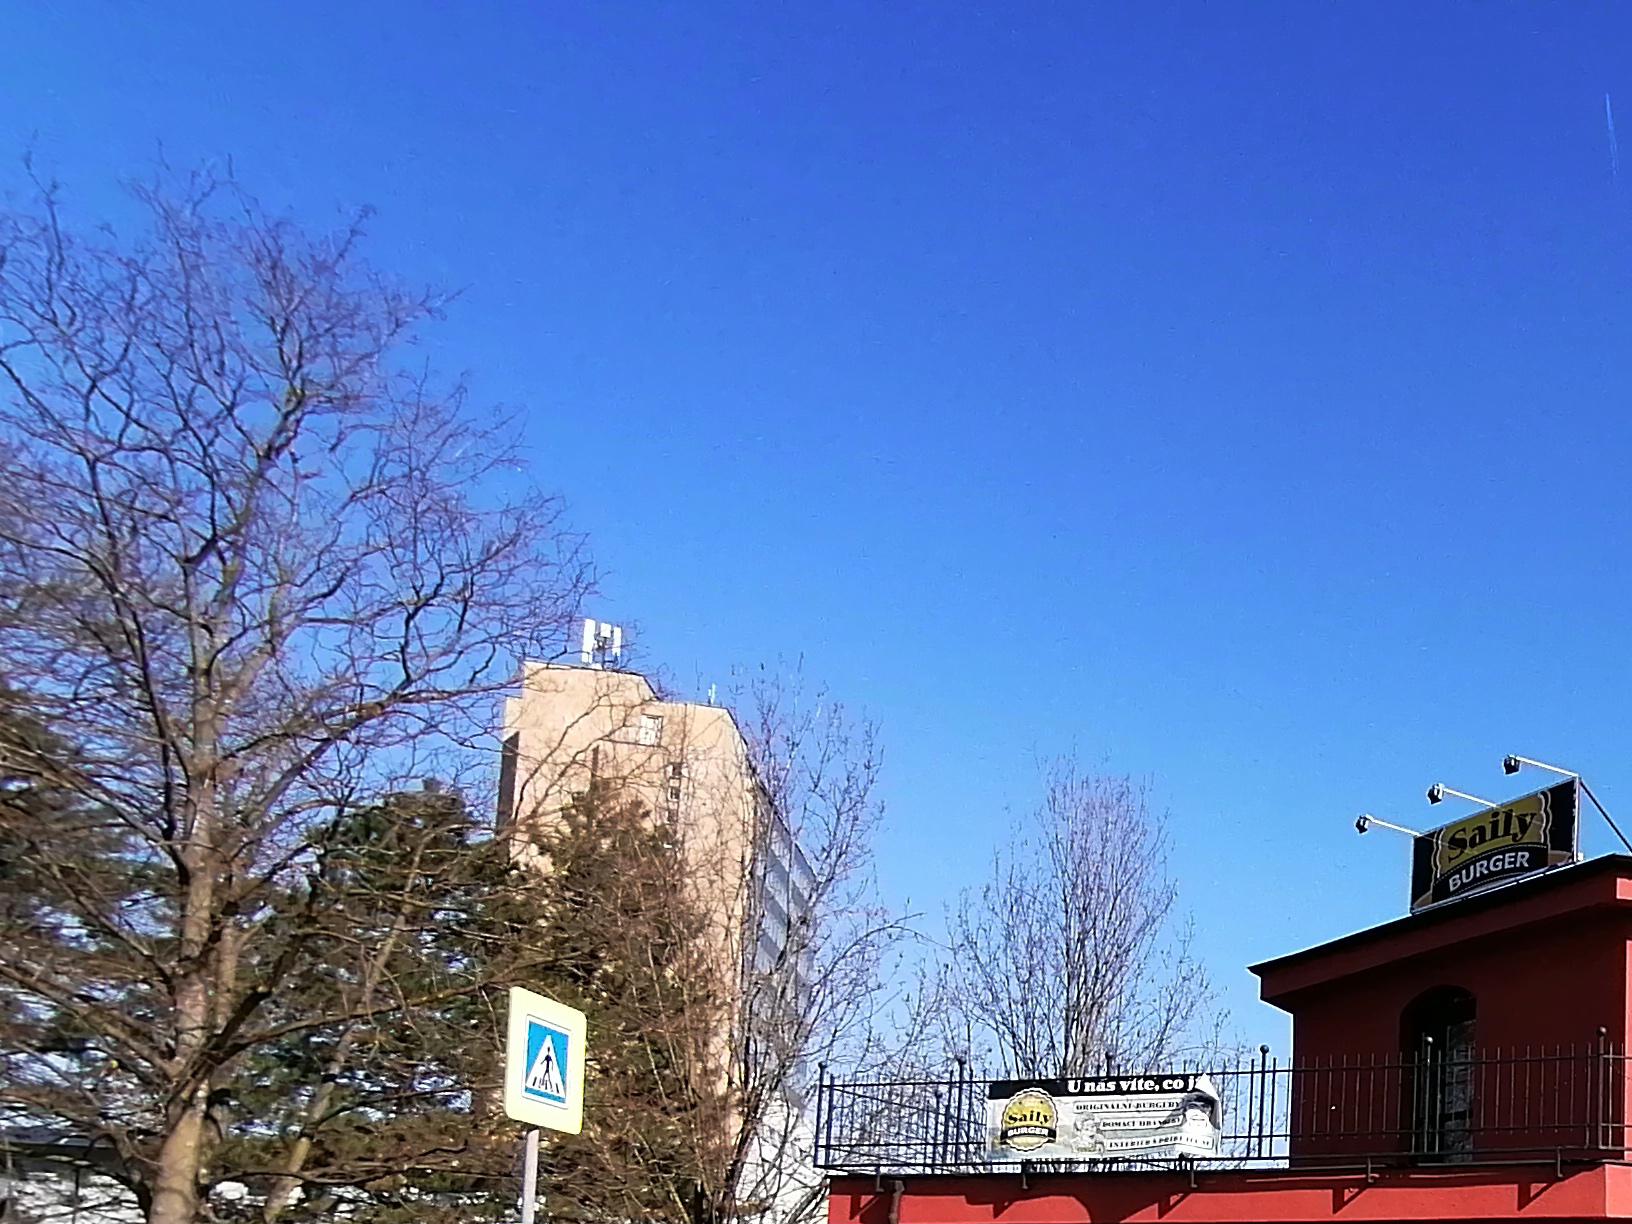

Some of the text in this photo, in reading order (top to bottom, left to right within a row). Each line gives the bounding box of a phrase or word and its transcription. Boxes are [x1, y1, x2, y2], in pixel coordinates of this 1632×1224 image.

[1447, 808, 1537, 862] Saily
[1448, 851, 1531, 892] BURGER
[1067, 1079, 1081, 1093] U
[1162, 1078, 1185, 1090] co
[1004, 1110, 1052, 1125] Saily
[1007, 1127, 1049, 1137] BURGER
